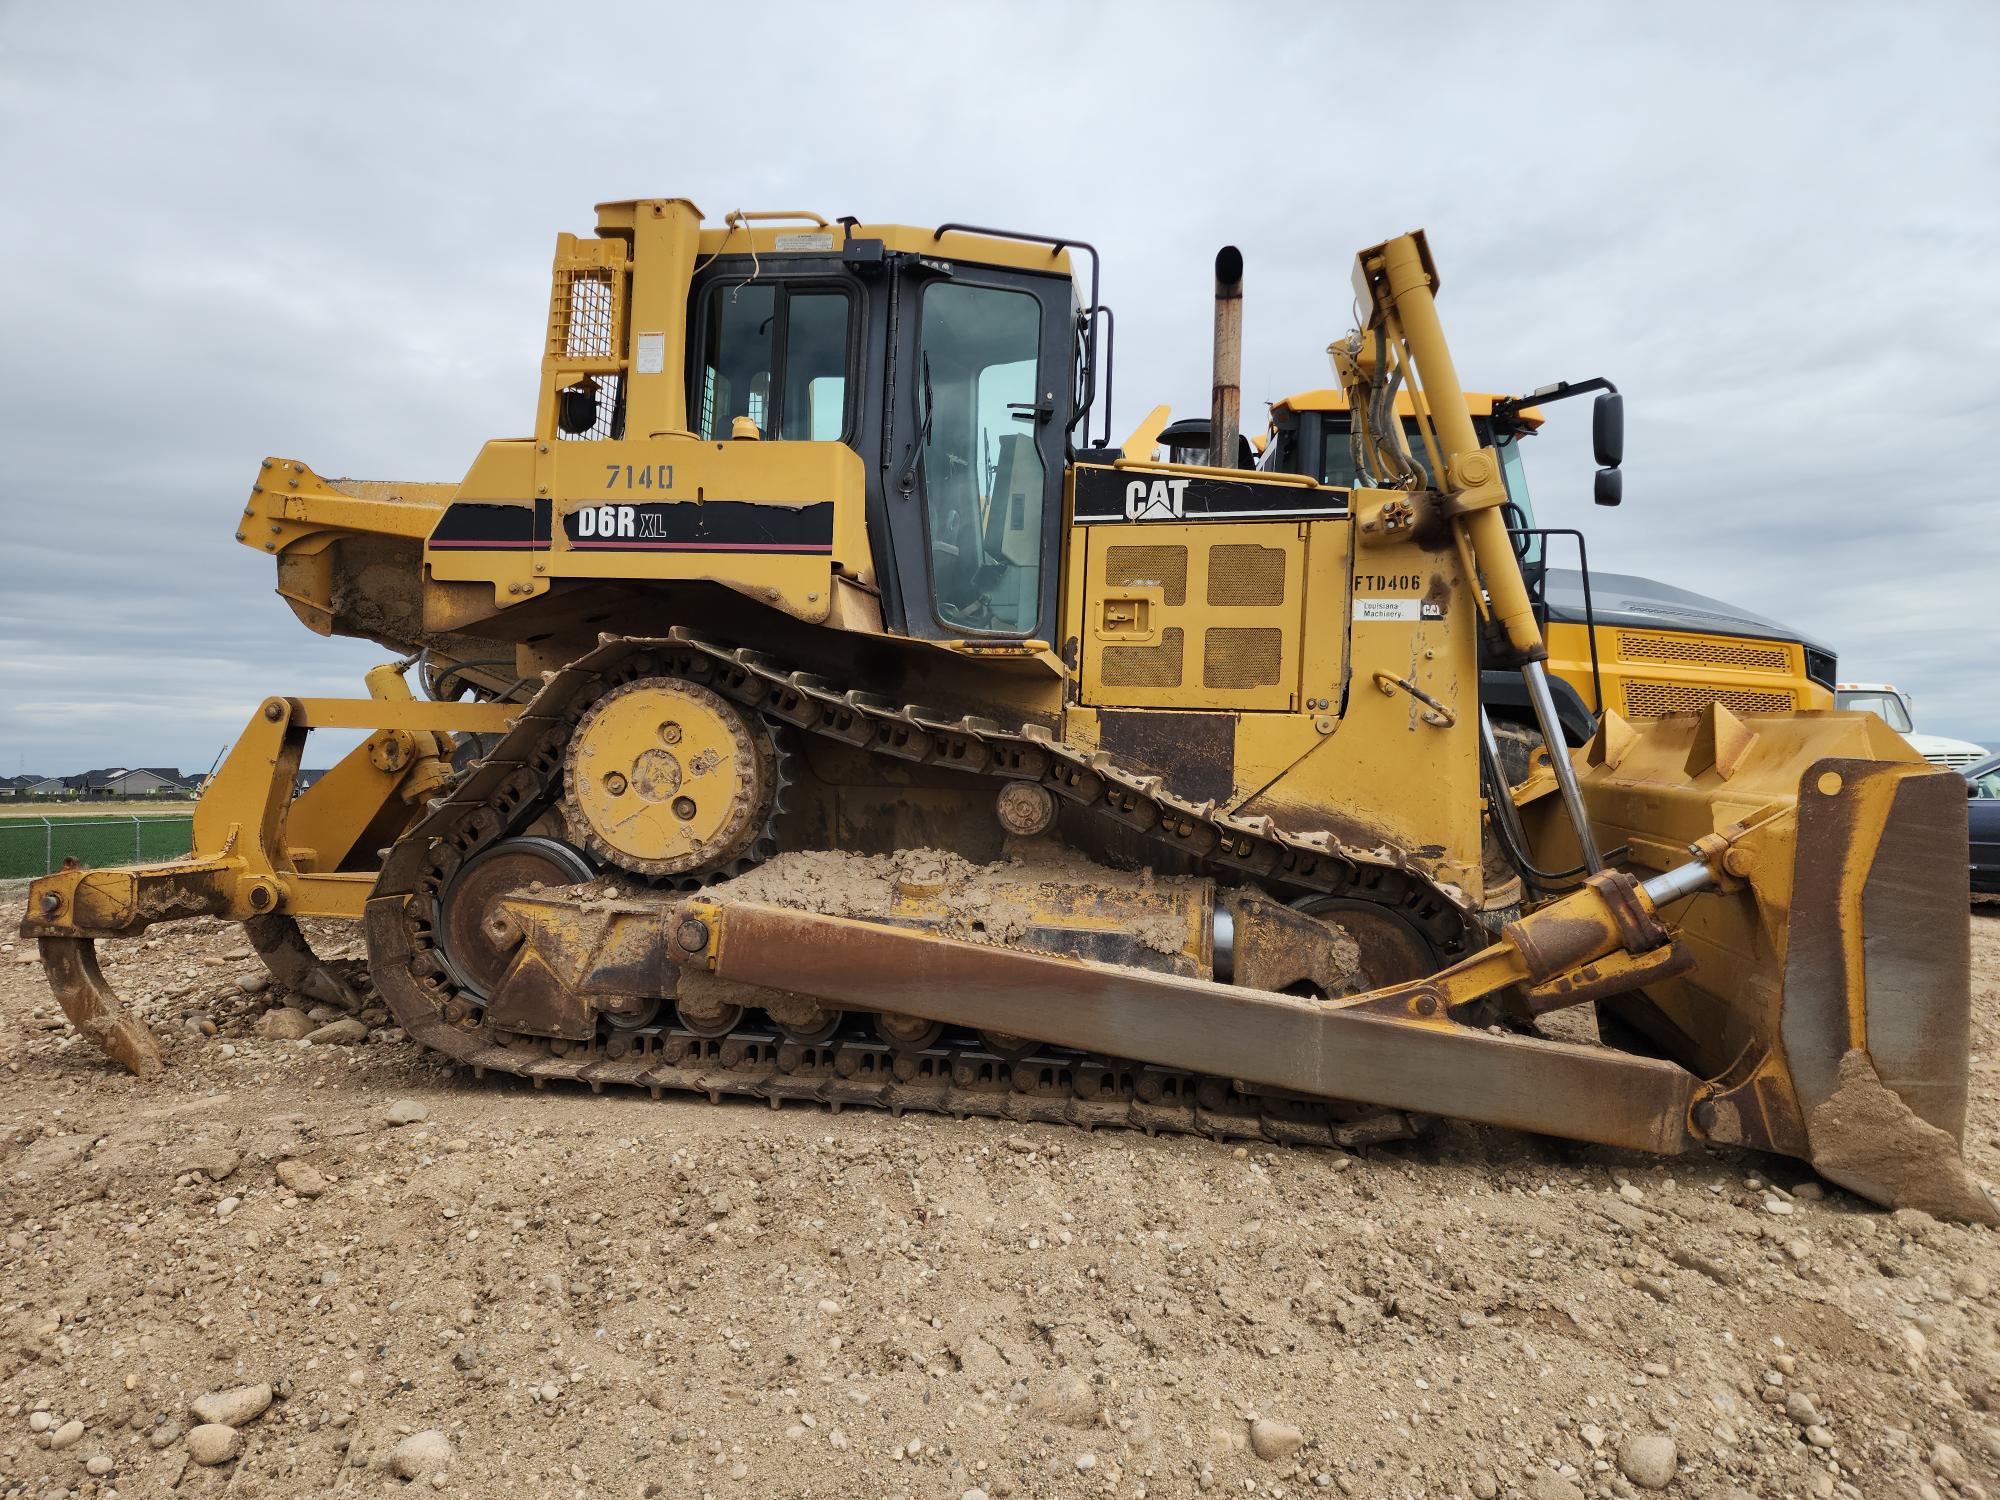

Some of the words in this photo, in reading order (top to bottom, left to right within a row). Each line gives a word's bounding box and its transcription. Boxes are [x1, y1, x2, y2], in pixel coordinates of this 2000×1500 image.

[606, 465, 673, 489] 7140
[1126, 480, 1189, 519] CAT
[579, 506, 635, 537] D6R
[639, 513, 667, 537] XL
[1354, 575, 1420, 590] FTD406
[1363, 602, 1399, 610] Louisiana
